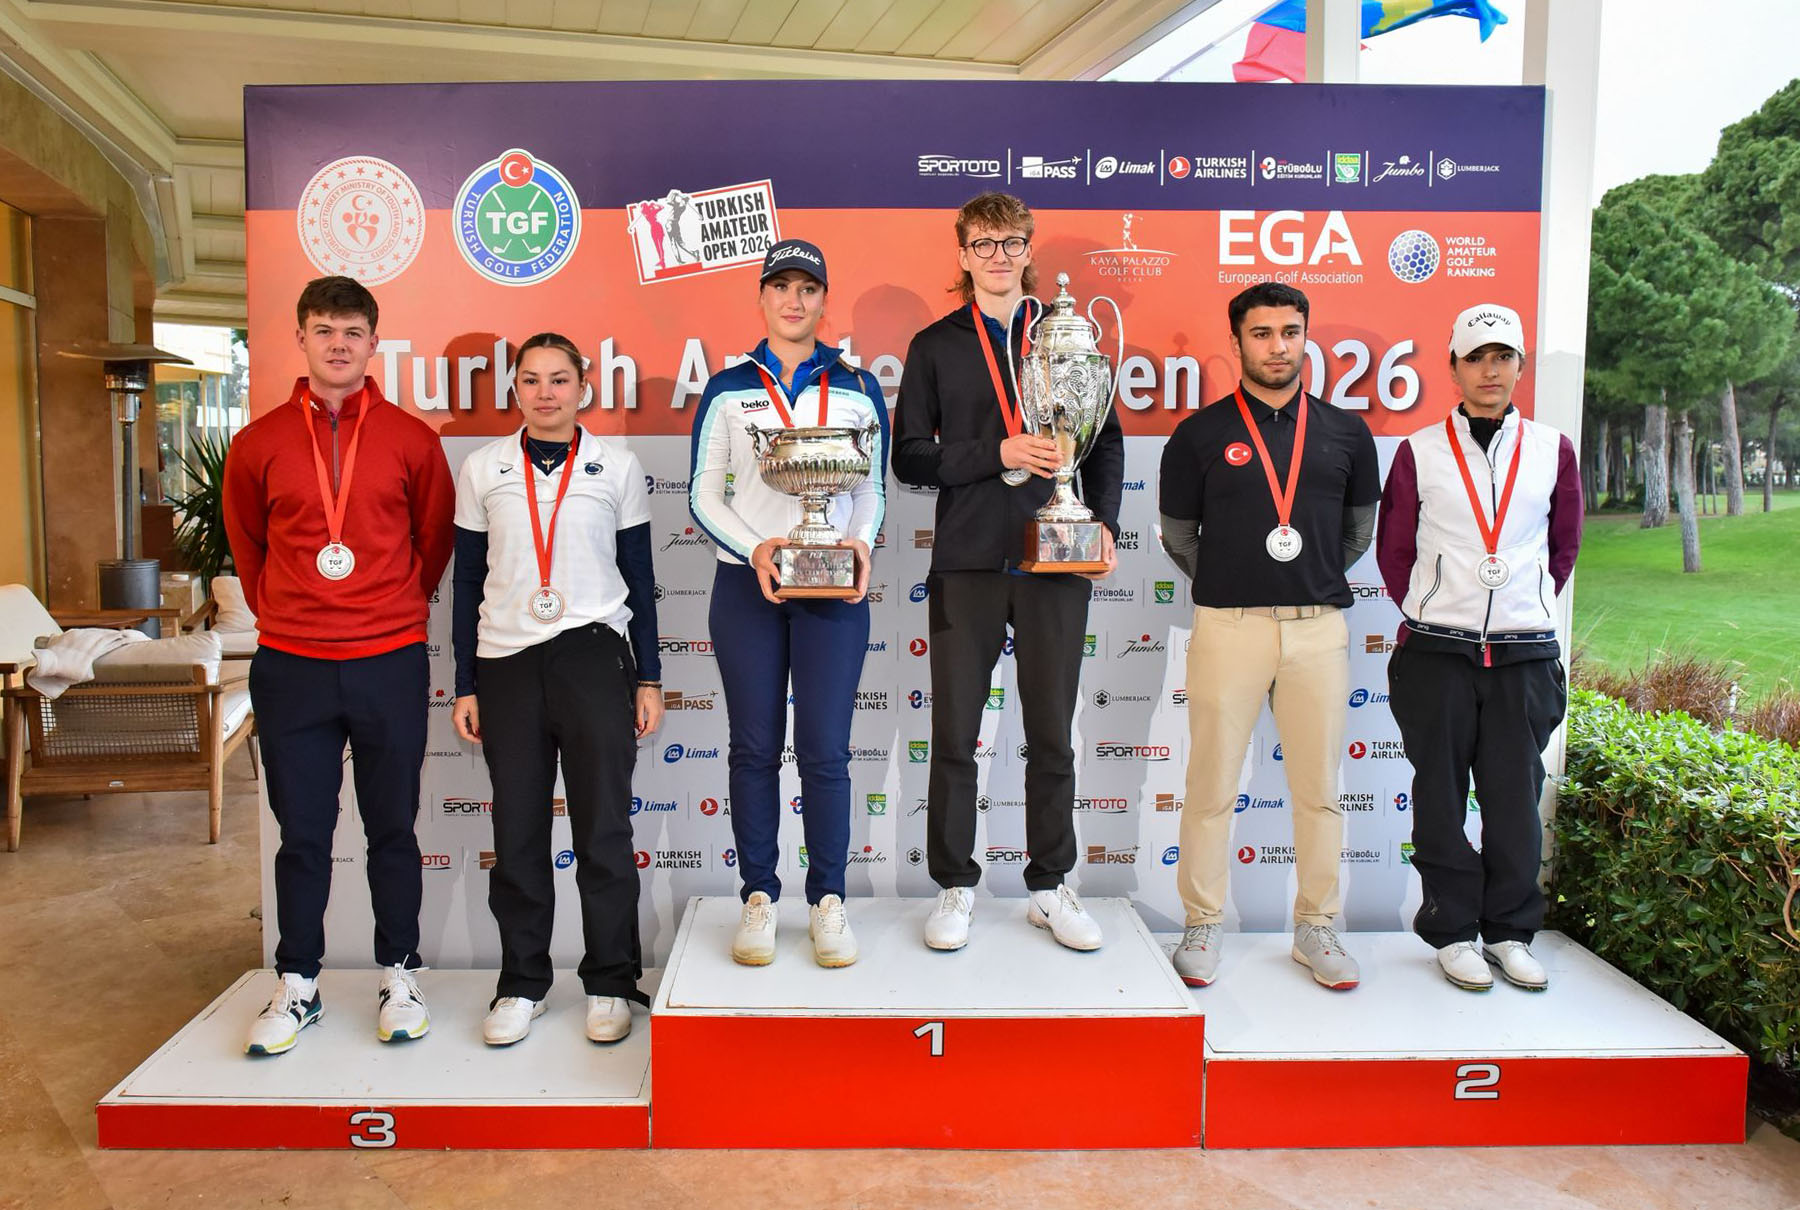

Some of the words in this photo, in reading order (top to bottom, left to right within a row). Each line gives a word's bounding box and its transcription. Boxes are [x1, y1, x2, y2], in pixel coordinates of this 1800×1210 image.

[918, 160, 1000, 172] SPORTOTO
[1195, 157, 1246, 167] TURKISH
[1044, 166, 1076, 178] PASS
[1119, 161, 1155, 174] Limak
[1277, 163, 1322, 173] EYÜBOĞLU
[1373, 161, 1424, 183] Jumbo
[1457, 165, 1500, 173] LUMBERJACK
[1194, 168, 1246, 179] AIRLINES
[340, 181, 375, 193] MINISTRY
[376, 187, 386, 198] OF
[322, 191, 341, 218] TURKEY
[384, 194, 400, 220] YOUTH
[694, 191, 765, 222] TURKISH
[486, 211, 549, 235] TGF
[700, 213, 769, 243] AMATEUR
[391, 221, 401, 239] AND
[463, 191, 482, 254] TURKISH
[484, 257, 520, 276] GOLF
[530, 191, 571, 273] FEDERATION
[1218, 210, 1363, 265] EGA
[1445, 237, 1486, 246] WORLD
[703, 239, 738, 262] OPEN
[740, 236, 773, 255] 2026
[1447, 247, 1497, 256] AMATEUR
[768, 246, 822, 267] Titleist
[1090, 257, 1119, 265] KAYA
[1122, 257, 1170, 266] PALAZZO
[1446, 257, 1475, 267] GOLF
[1098, 267, 1129, 276] GOLF
[1132, 267, 1162, 276] CLUB
[1447, 267, 1496, 278] RANKING
[1218, 271, 1272, 286] European
[1274, 271, 1299, 284] Golf
[1301, 271, 1363, 284] Association
[1467, 311, 1511, 328] Callaway
[376, 337, 637, 410] Turkh
[1118, 355, 1200, 411] en
[741, 400, 770, 409] beko
[656, 481, 688, 490] EYÜBOĞ
[1122, 480, 1146, 491] mak
[660, 533, 709, 552] Jumbo
[1116, 541, 1138, 549] INES
[868, 593, 883, 601] SS
[1093, 589, 1134, 597] EYÜBOĞLU
[1352, 587, 1388, 597] PORT
[658, 641, 713, 652] PORTOT
[867, 641, 887, 651] mak
[1117, 640, 1165, 658] Jumbo
[856, 692, 887, 700] RKISH
[1370, 693, 1391, 703] Lim
[684, 700, 714, 710] PASS
[855, 702, 887, 710] RLINES
[1372, 742, 1402, 750] TURKI
[686, 748, 719, 758] Limak
[853, 749, 888, 757] YÜBOĞLU
[1096, 746, 1170, 757] SPORTOTO
[1371, 751, 1407, 759] AIRLIN
[1251, 798, 1284, 808] Limak
[1338, 794, 1374, 802] URKISH
[443, 802, 493, 813] SPORT
[644, 801, 677, 811] Limak
[1074, 799, 1127, 809] ORTOTO
[1341, 803, 1374, 811] RLINES
[656, 851, 701, 859] TURKISH
[986, 851, 1030, 861] SPORT
[1261, 847, 1296, 855] TURKIS
[1341, 850, 1380, 858] EYÜBOĞLU
[848, 851, 887, 864] Jumbo
[1107, 854, 1136, 864] PASS
[1260, 856, 1296, 864] AIRLIN
[655, 860, 702, 869] AIRLINES
[913, 1022, 945, 1057] 1
[1454, 1064, 1500, 1100] 2
[350, 1111, 396, 1148] 3
